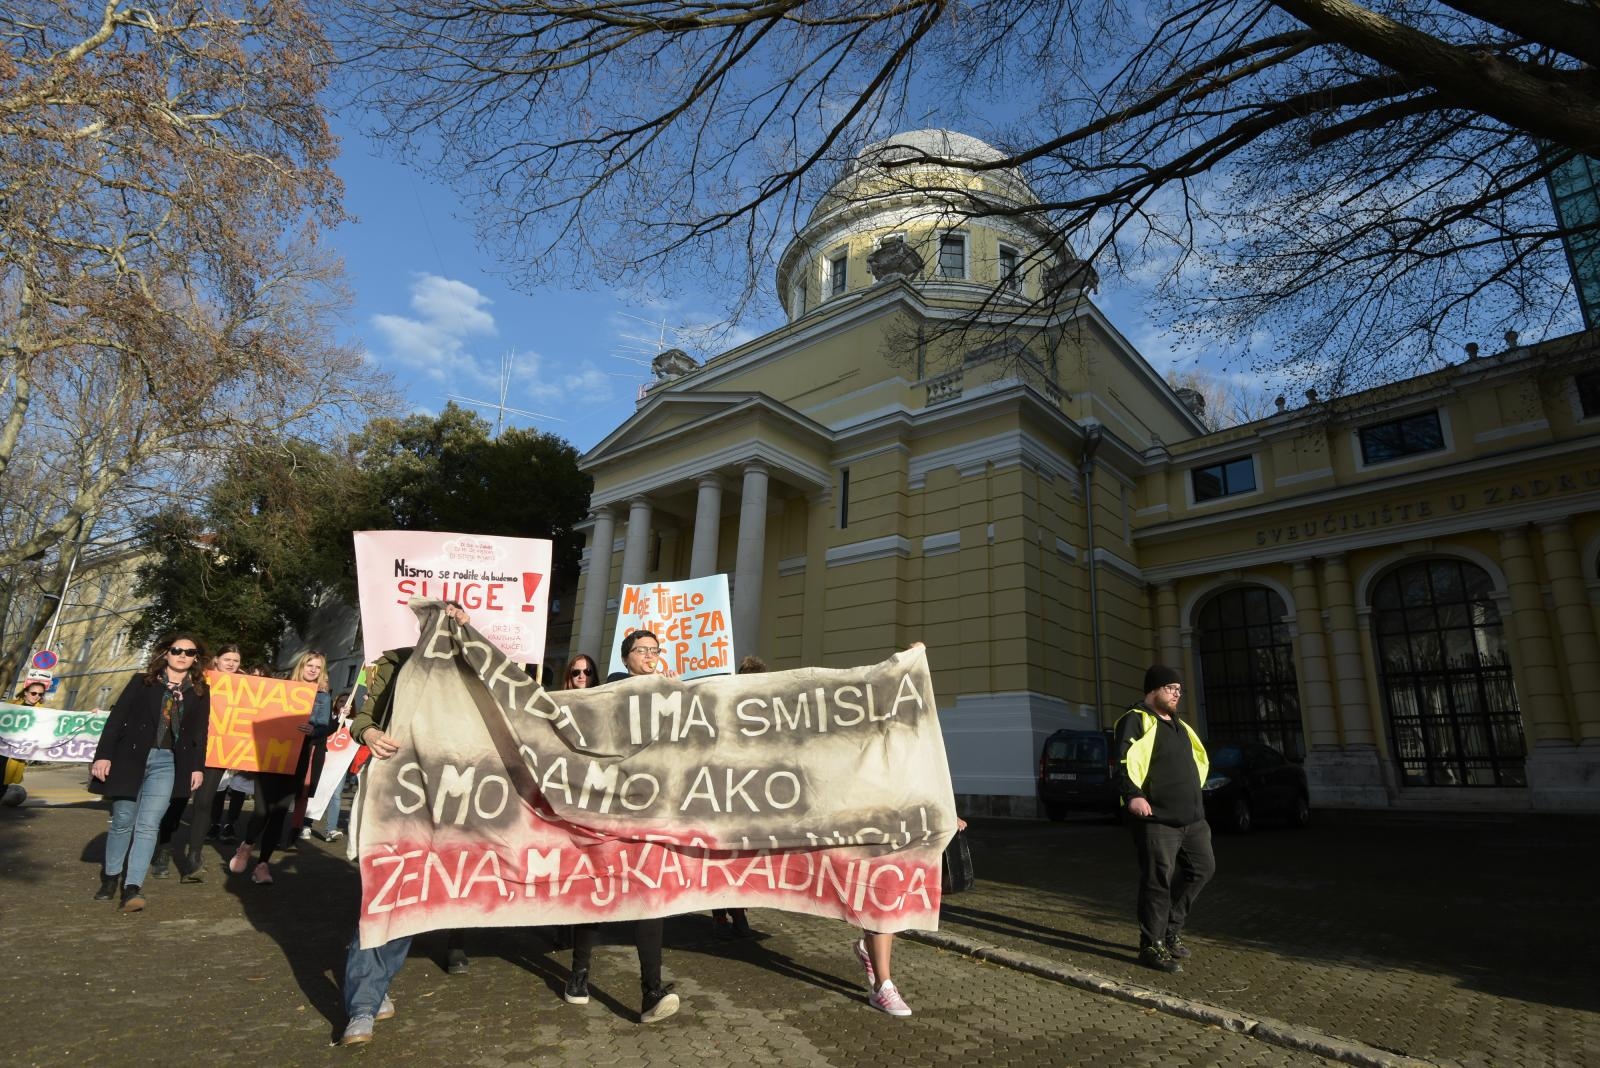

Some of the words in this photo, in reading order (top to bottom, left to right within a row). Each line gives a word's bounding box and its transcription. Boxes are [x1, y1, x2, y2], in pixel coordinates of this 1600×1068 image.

[1256, 501, 1432, 545] SVEUČILIŠTE
[1448, 494, 1466, 512] U
[1483, 468, 1600, 506] ZADRU
[394, 558, 434, 579] Nismo
[438, 570, 450, 579] se
[481, 570, 490, 582] da
[491, 571, 519, 583] budemo
[695, 610, 726, 638] ZA
[206, 672, 317, 715] ANAS
[629, 689, 716, 745] IMA
[735, 672, 926, 738] SMISLA
[394, 760, 509, 826] SMO
[680, 765, 801, 814] AKO
[698, 846, 934, 912] RADNICA
